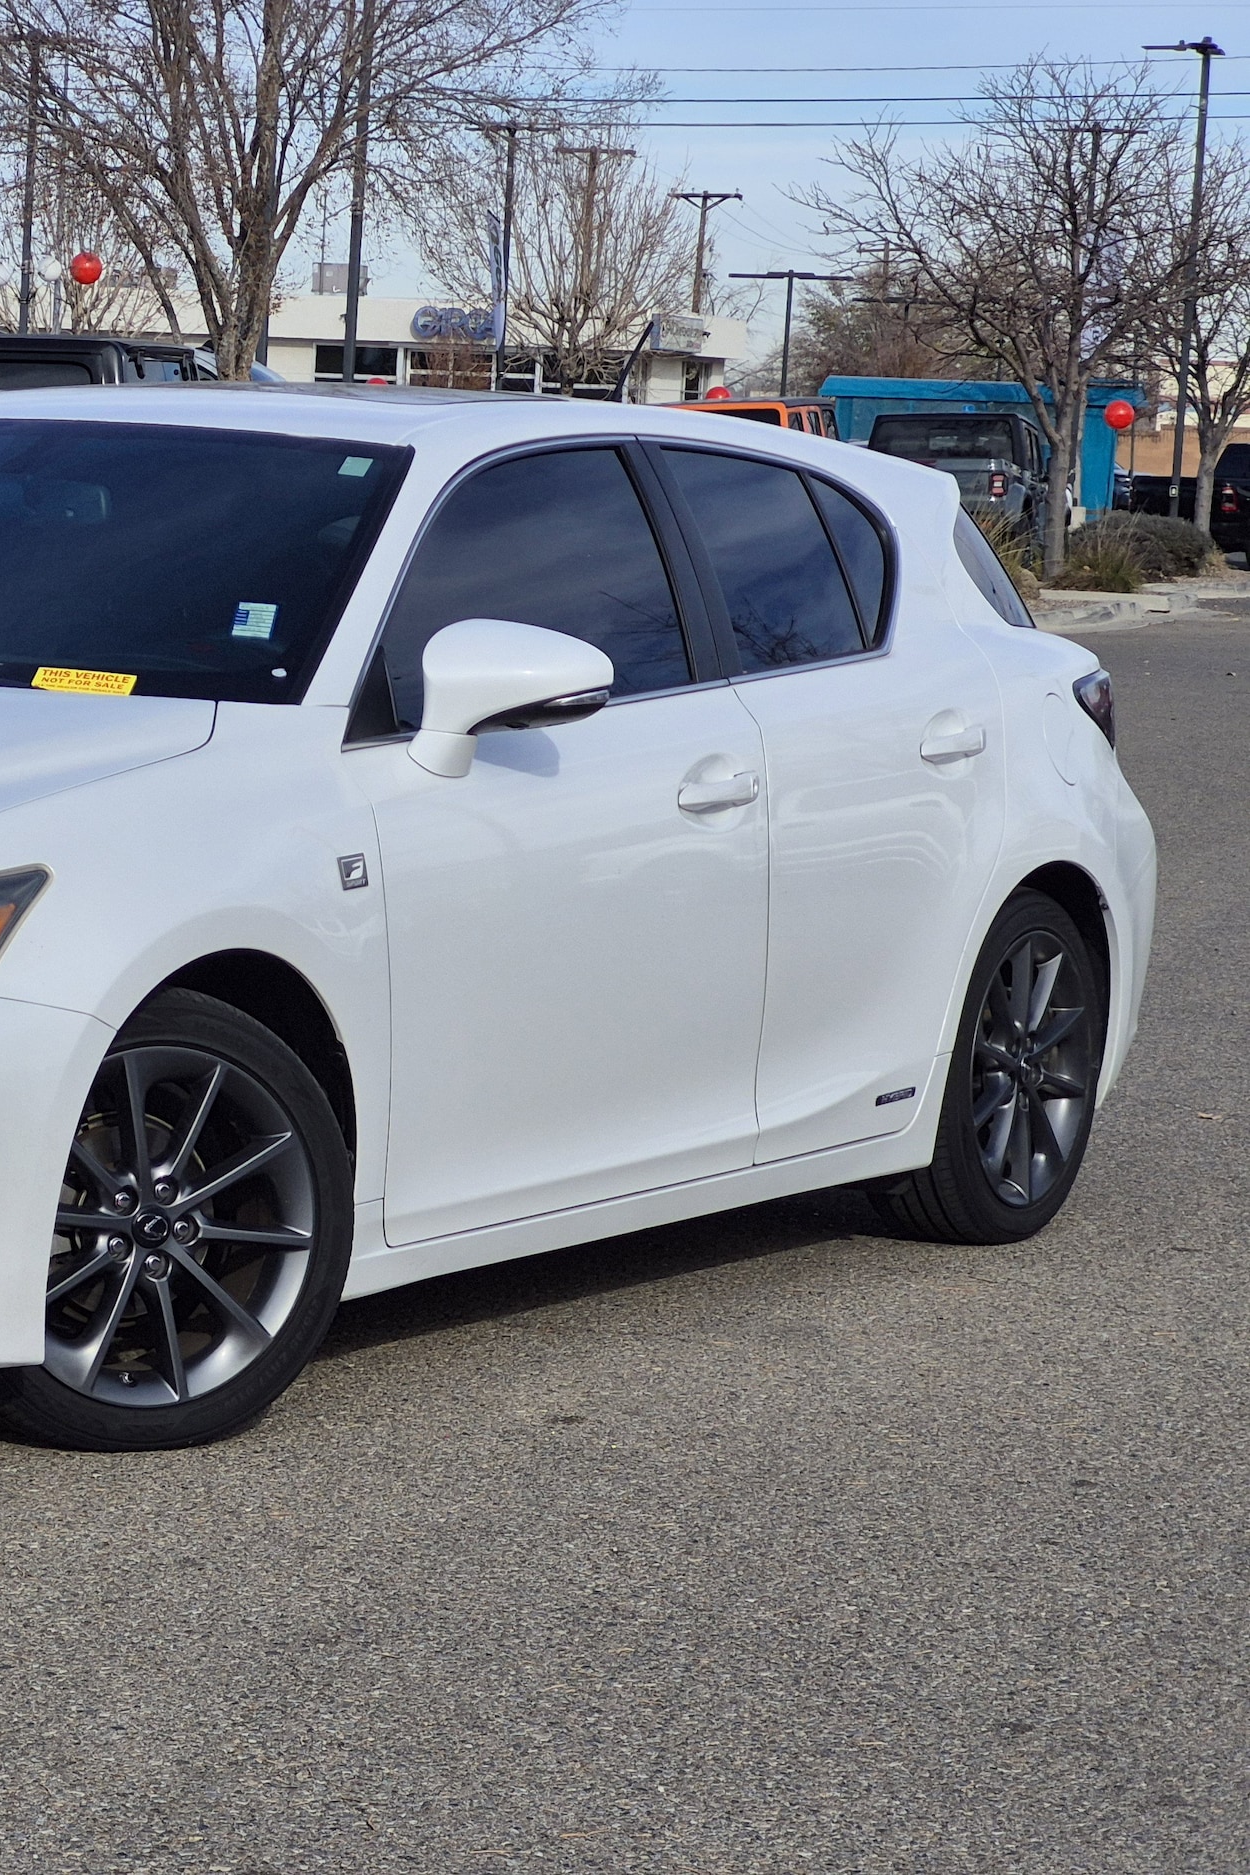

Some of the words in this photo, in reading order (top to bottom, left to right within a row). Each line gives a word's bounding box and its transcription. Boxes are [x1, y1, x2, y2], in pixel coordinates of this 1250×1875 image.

[42, 669, 71, 678] THIS
[75, 671, 131, 684] VEHICLE
[94, 681, 125, 690] SALE
